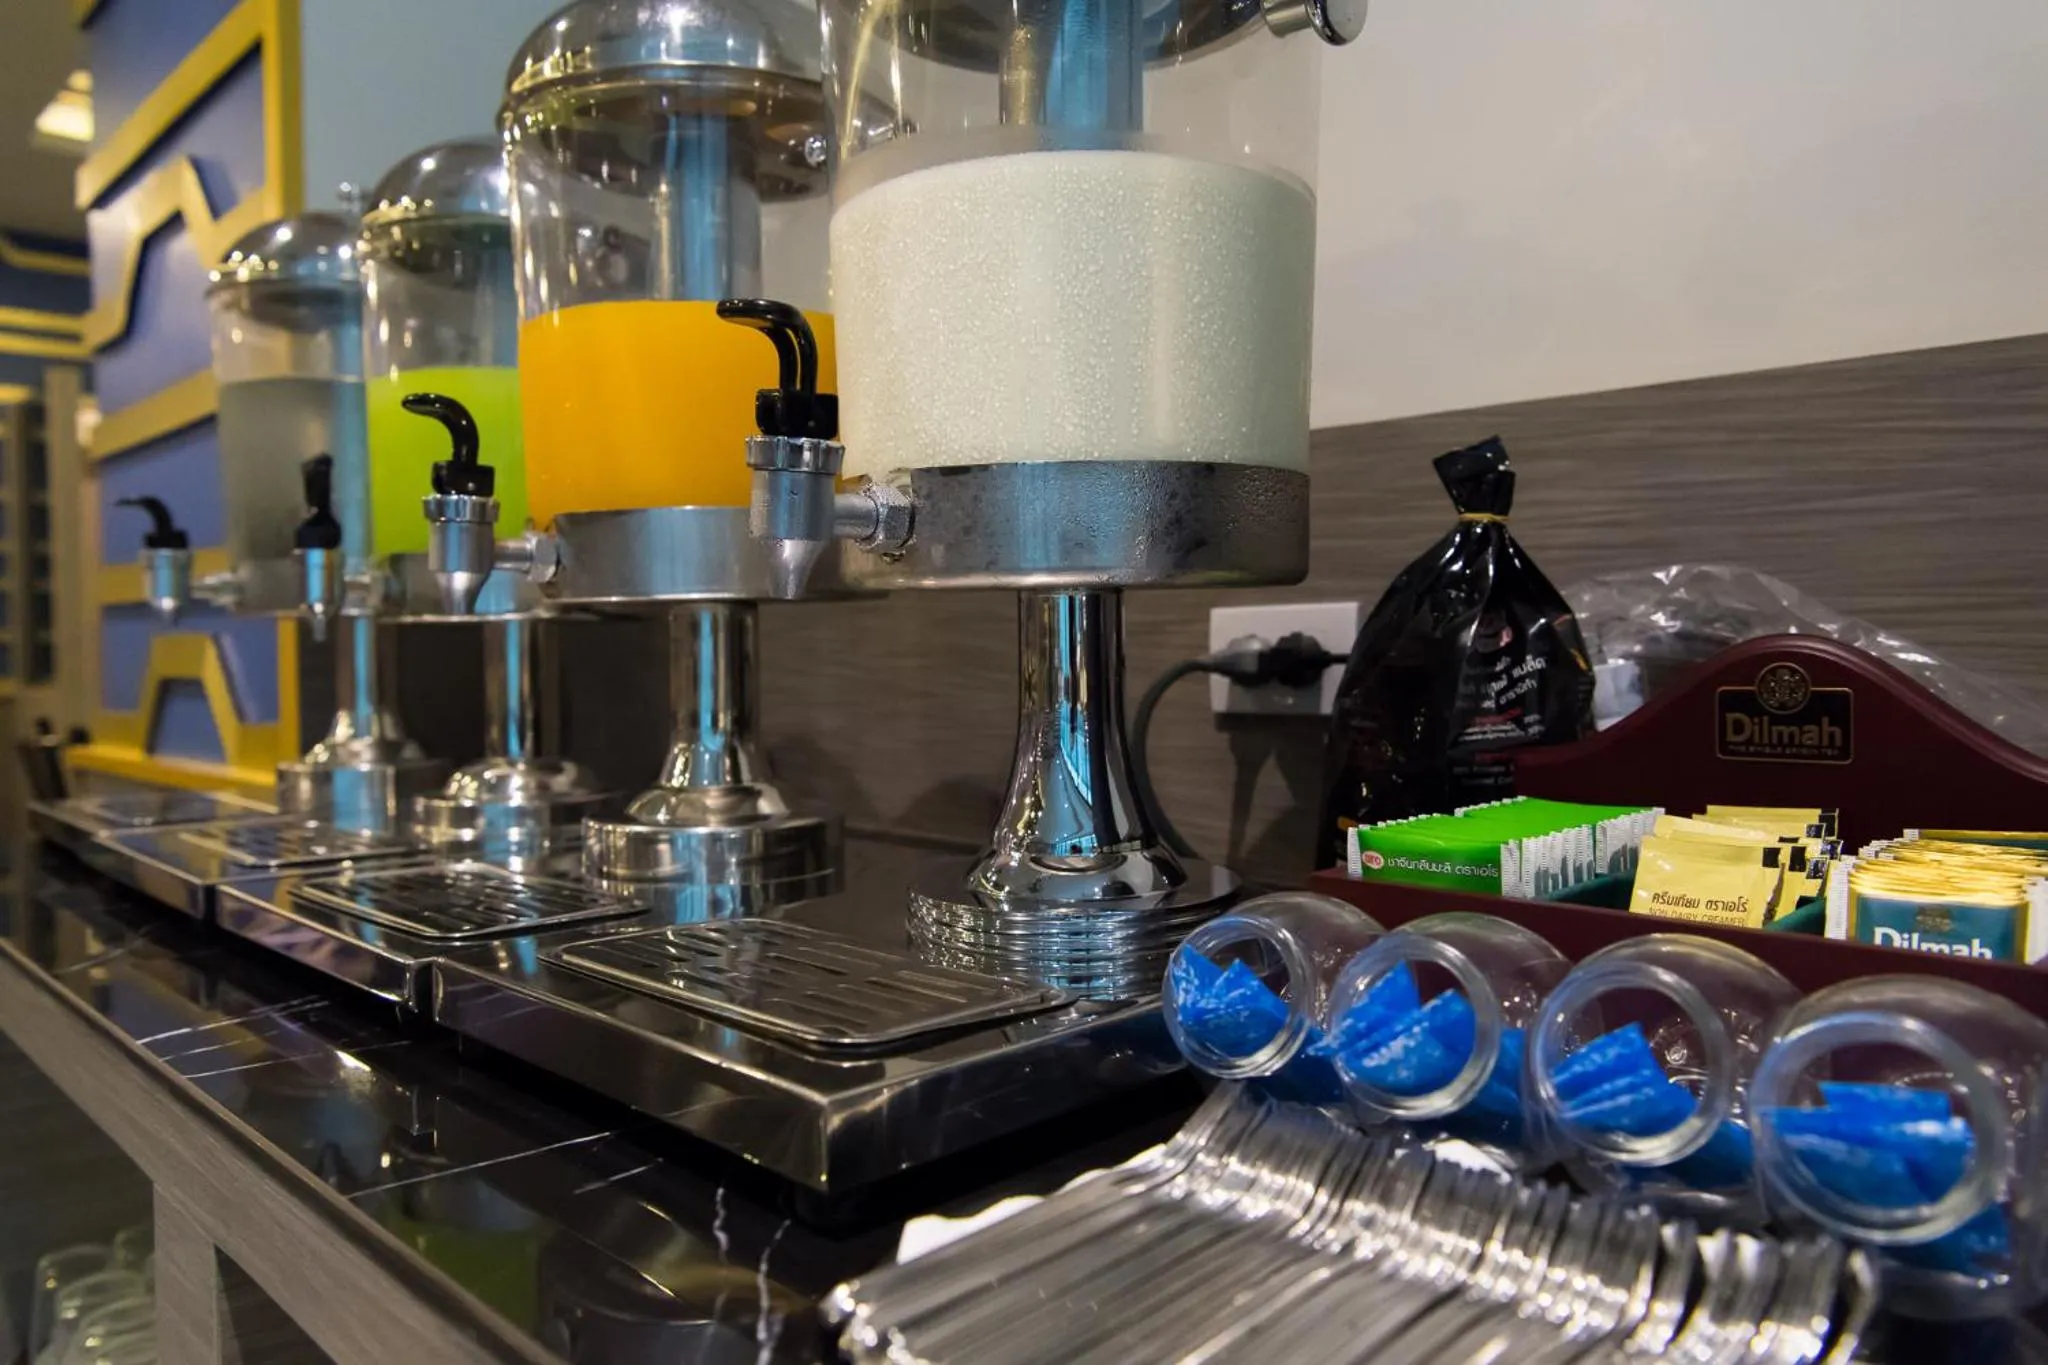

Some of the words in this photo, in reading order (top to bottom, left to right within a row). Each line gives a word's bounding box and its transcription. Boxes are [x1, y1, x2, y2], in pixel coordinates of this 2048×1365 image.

[1725, 712, 1842, 747] Dilmah
[1651, 890, 1700, 909] ครีมเทียม
[1873, 927, 1993, 960] Dilmah
